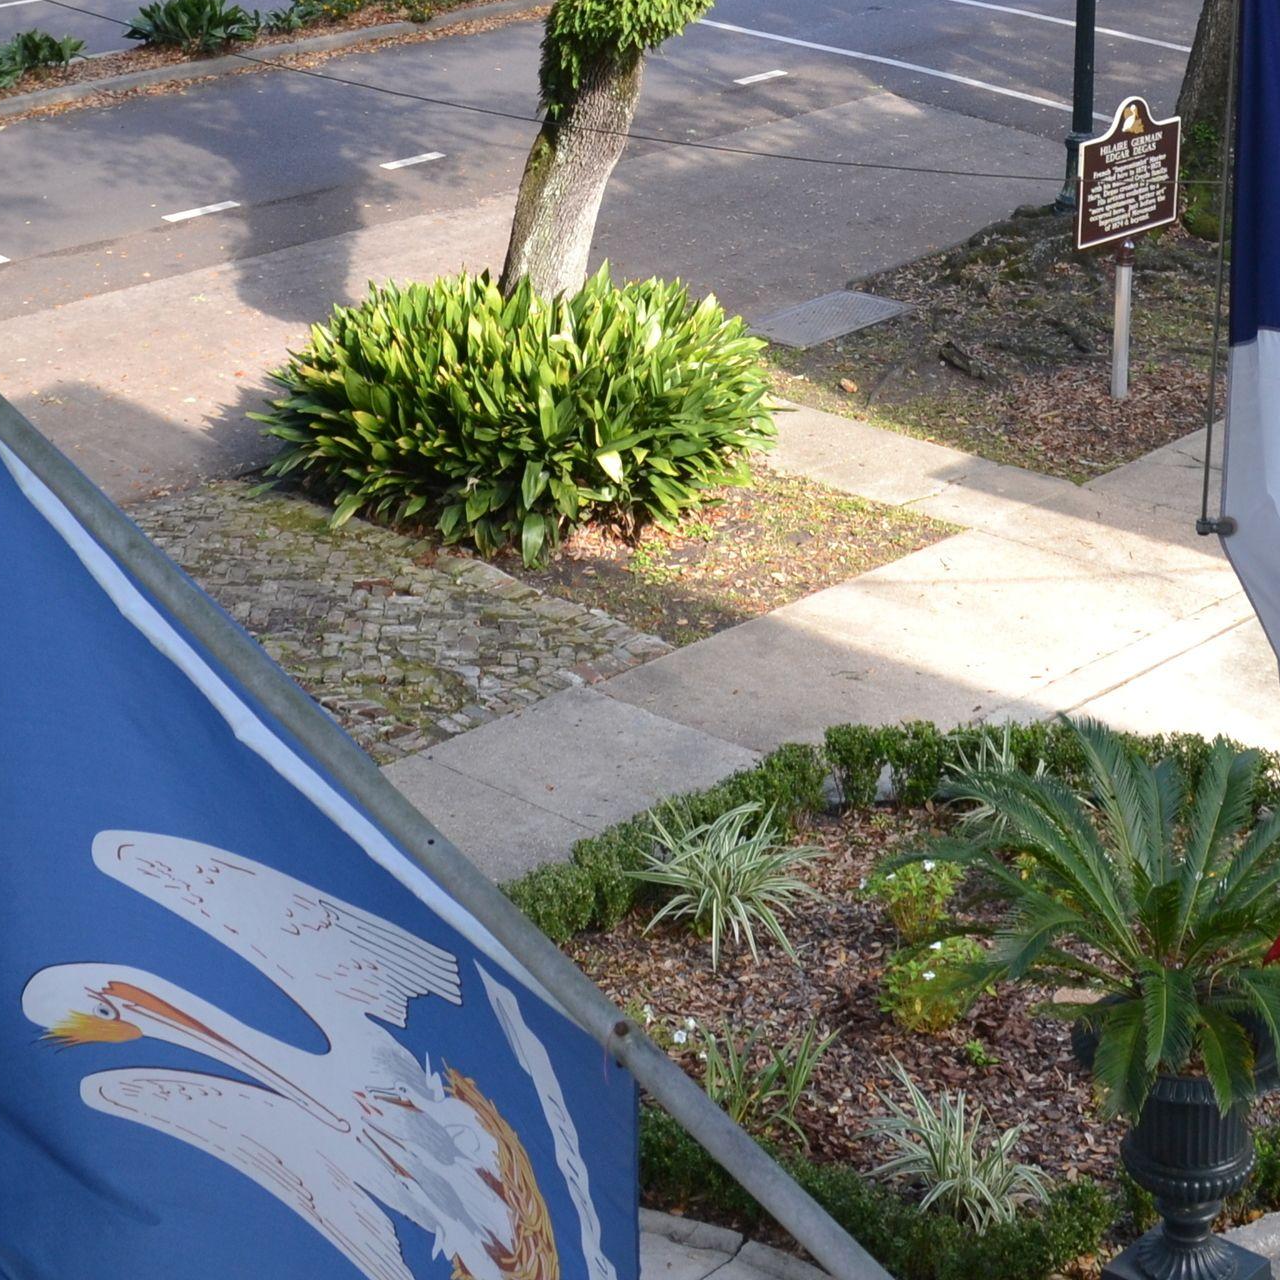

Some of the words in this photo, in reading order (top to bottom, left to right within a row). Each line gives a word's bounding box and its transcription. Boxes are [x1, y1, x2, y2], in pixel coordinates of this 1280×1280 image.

[1100, 140, 1128, 156] HILAIRE
[1131, 131, 1162, 147] GERMAIN
[1105, 149, 1129, 163] EDGAR
[1133, 142, 1156, 155] DEGAS
